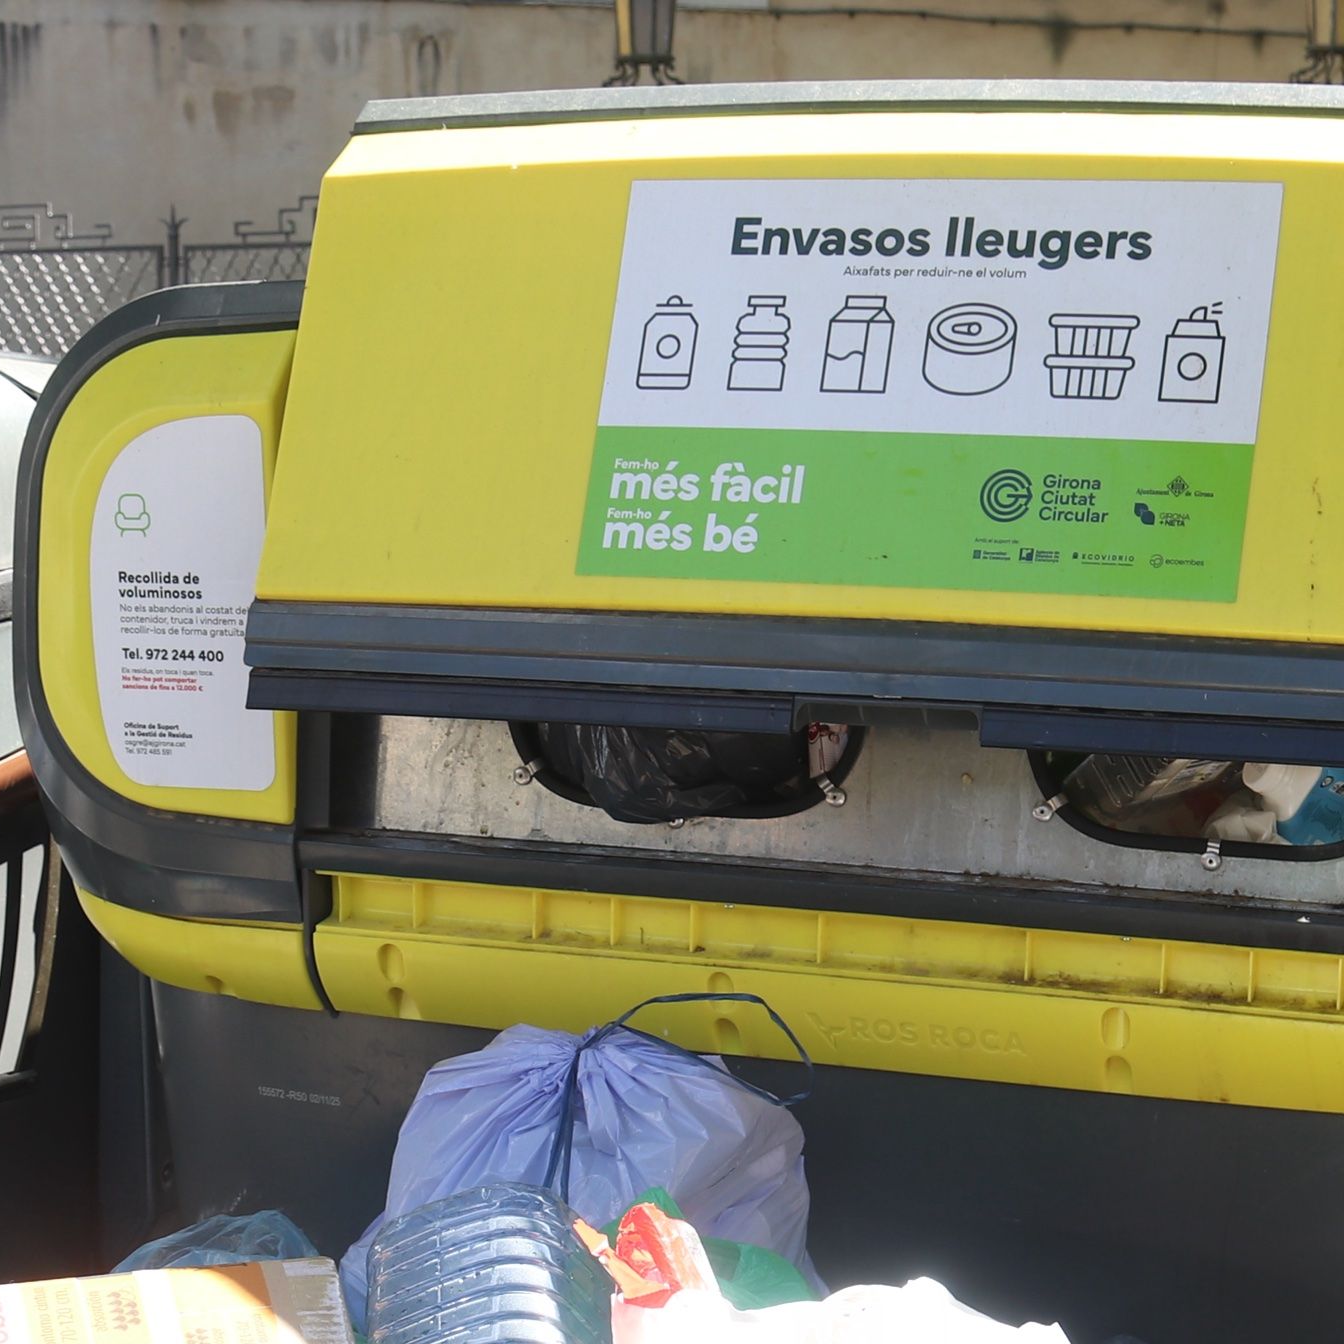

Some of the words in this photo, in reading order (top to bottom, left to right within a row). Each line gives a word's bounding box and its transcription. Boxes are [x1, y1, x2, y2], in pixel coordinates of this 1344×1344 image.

[730, 216, 931, 258] Envasos
[945, 216, 1153, 271] lleugers
[842, 265, 892, 278] Aixafats
[893, 267, 914, 280] per
[916, 266, 973, 279] reduir-ne
[976, 267, 987, 279] el
[989, 267, 1027, 280] volum
[614, 458, 659, 471] Fem-ho
[609, 461, 700, 501] més
[710, 462, 805, 504] fàcil
[1043, 474, 1101, 490] Girona
[1041, 490, 1096, 507] Ciutat
[607, 508, 652, 520] Fem-ho
[1039, 507, 1108, 523] Circular
[602, 511, 693, 551] més
[703, 513, 759, 553] bé
[118, 571, 180, 584] Recollida
[183, 572, 200, 584] de
[118, 586, 203, 599] voluminosos
[120, 604, 133, 613] No
[134, 604, 147, 613] els
[148, 604, 194, 614] abandonis
[195, 606, 203, 614] al
[205, 606, 233, 615] costat
[170, 616, 194, 625] truca
[200, 617, 237, 626] vindrem
[120, 626, 166, 635] recollir-los
[167, 626, 179, 635] de
[181, 627, 208, 636] forma
[122, 648, 143, 660] Tel.
[145, 648, 168, 660] 972
[171, 649, 195, 661] 244
[198, 650, 224, 662] 400
[849, 1016, 921, 1046] ROS
[928, 1023, 1027, 1057] ROCA
